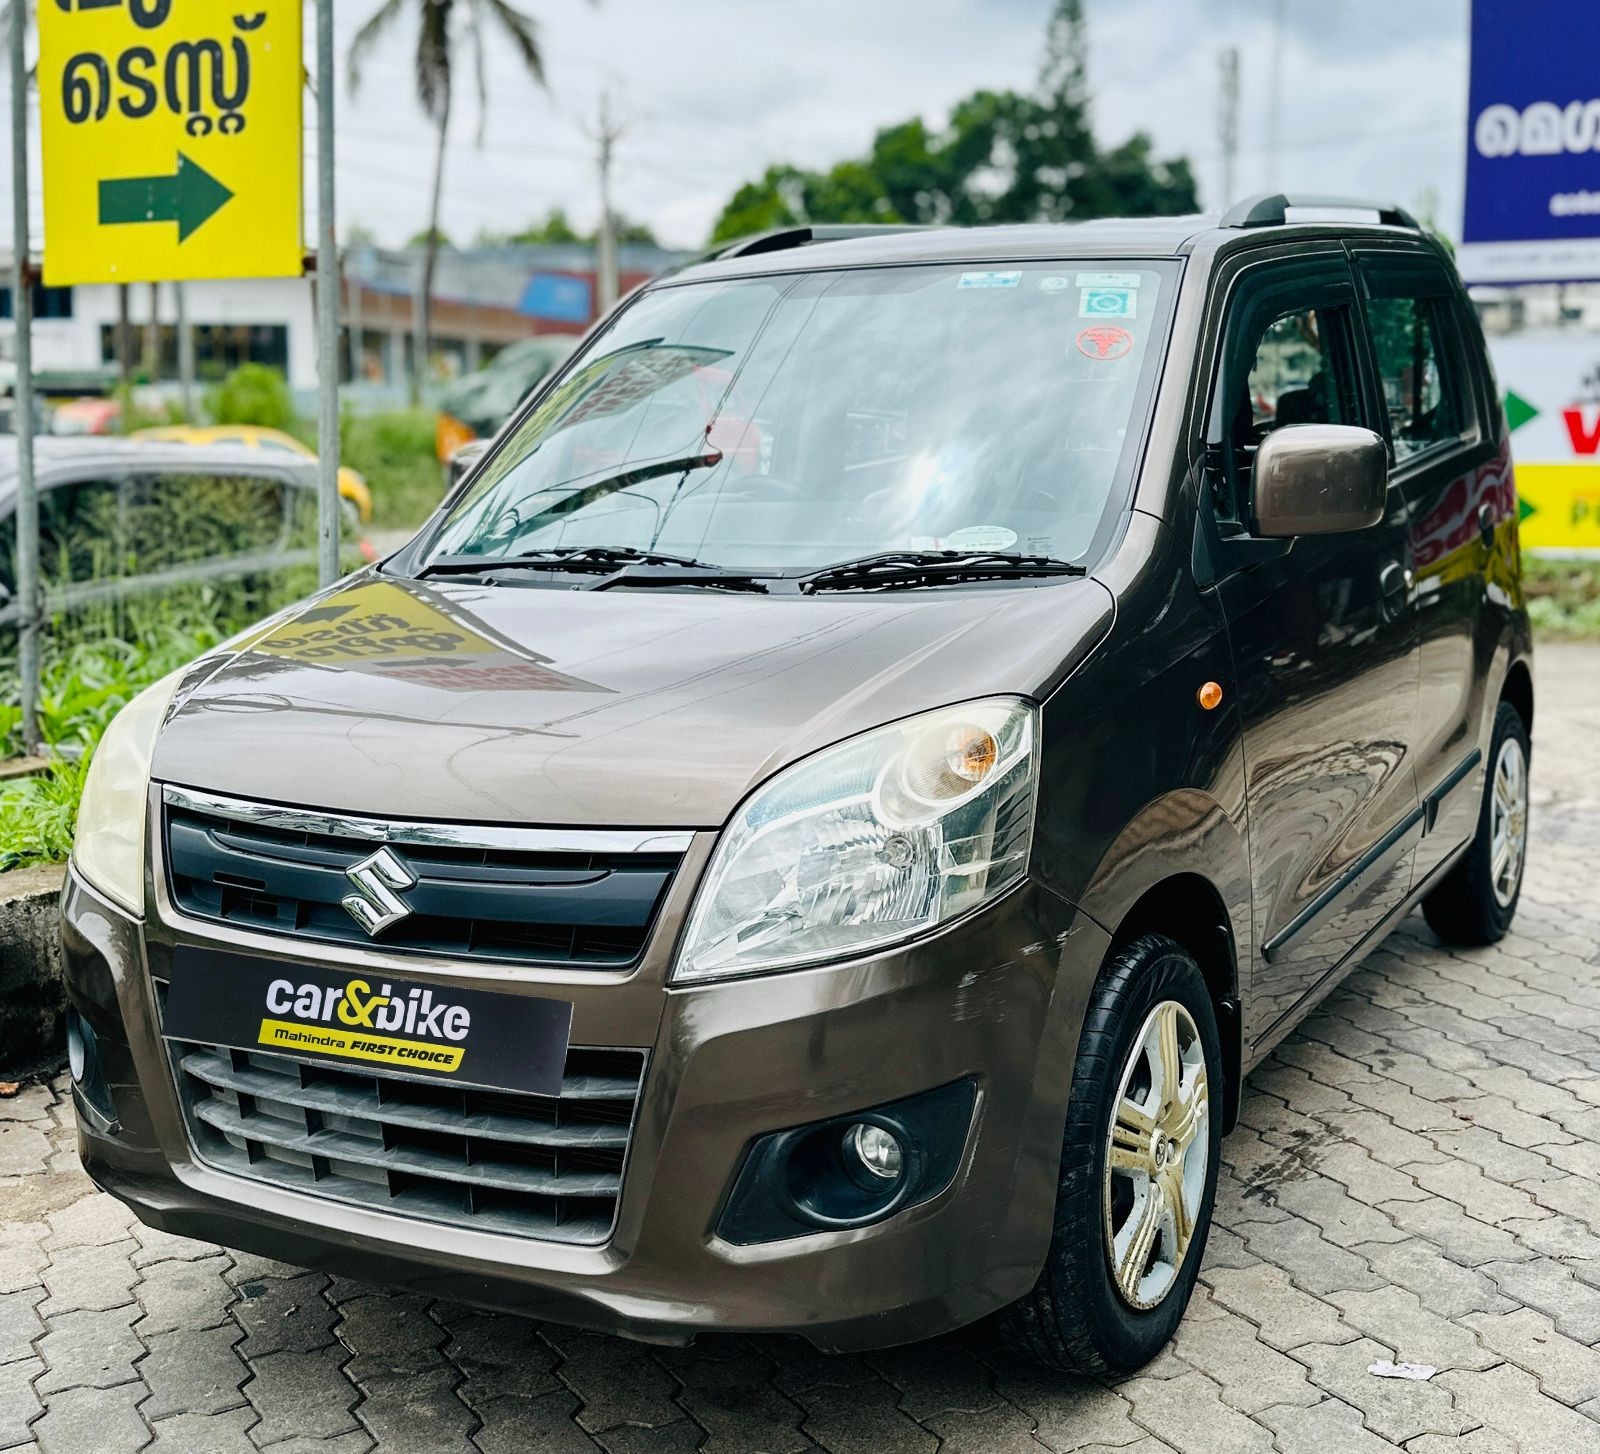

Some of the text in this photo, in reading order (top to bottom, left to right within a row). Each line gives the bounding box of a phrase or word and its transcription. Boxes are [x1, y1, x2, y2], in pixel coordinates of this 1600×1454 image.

[266, 979, 471, 1041] car&bike
[274, 1028, 455, 1065] Mahindra FIRST CHOICE
